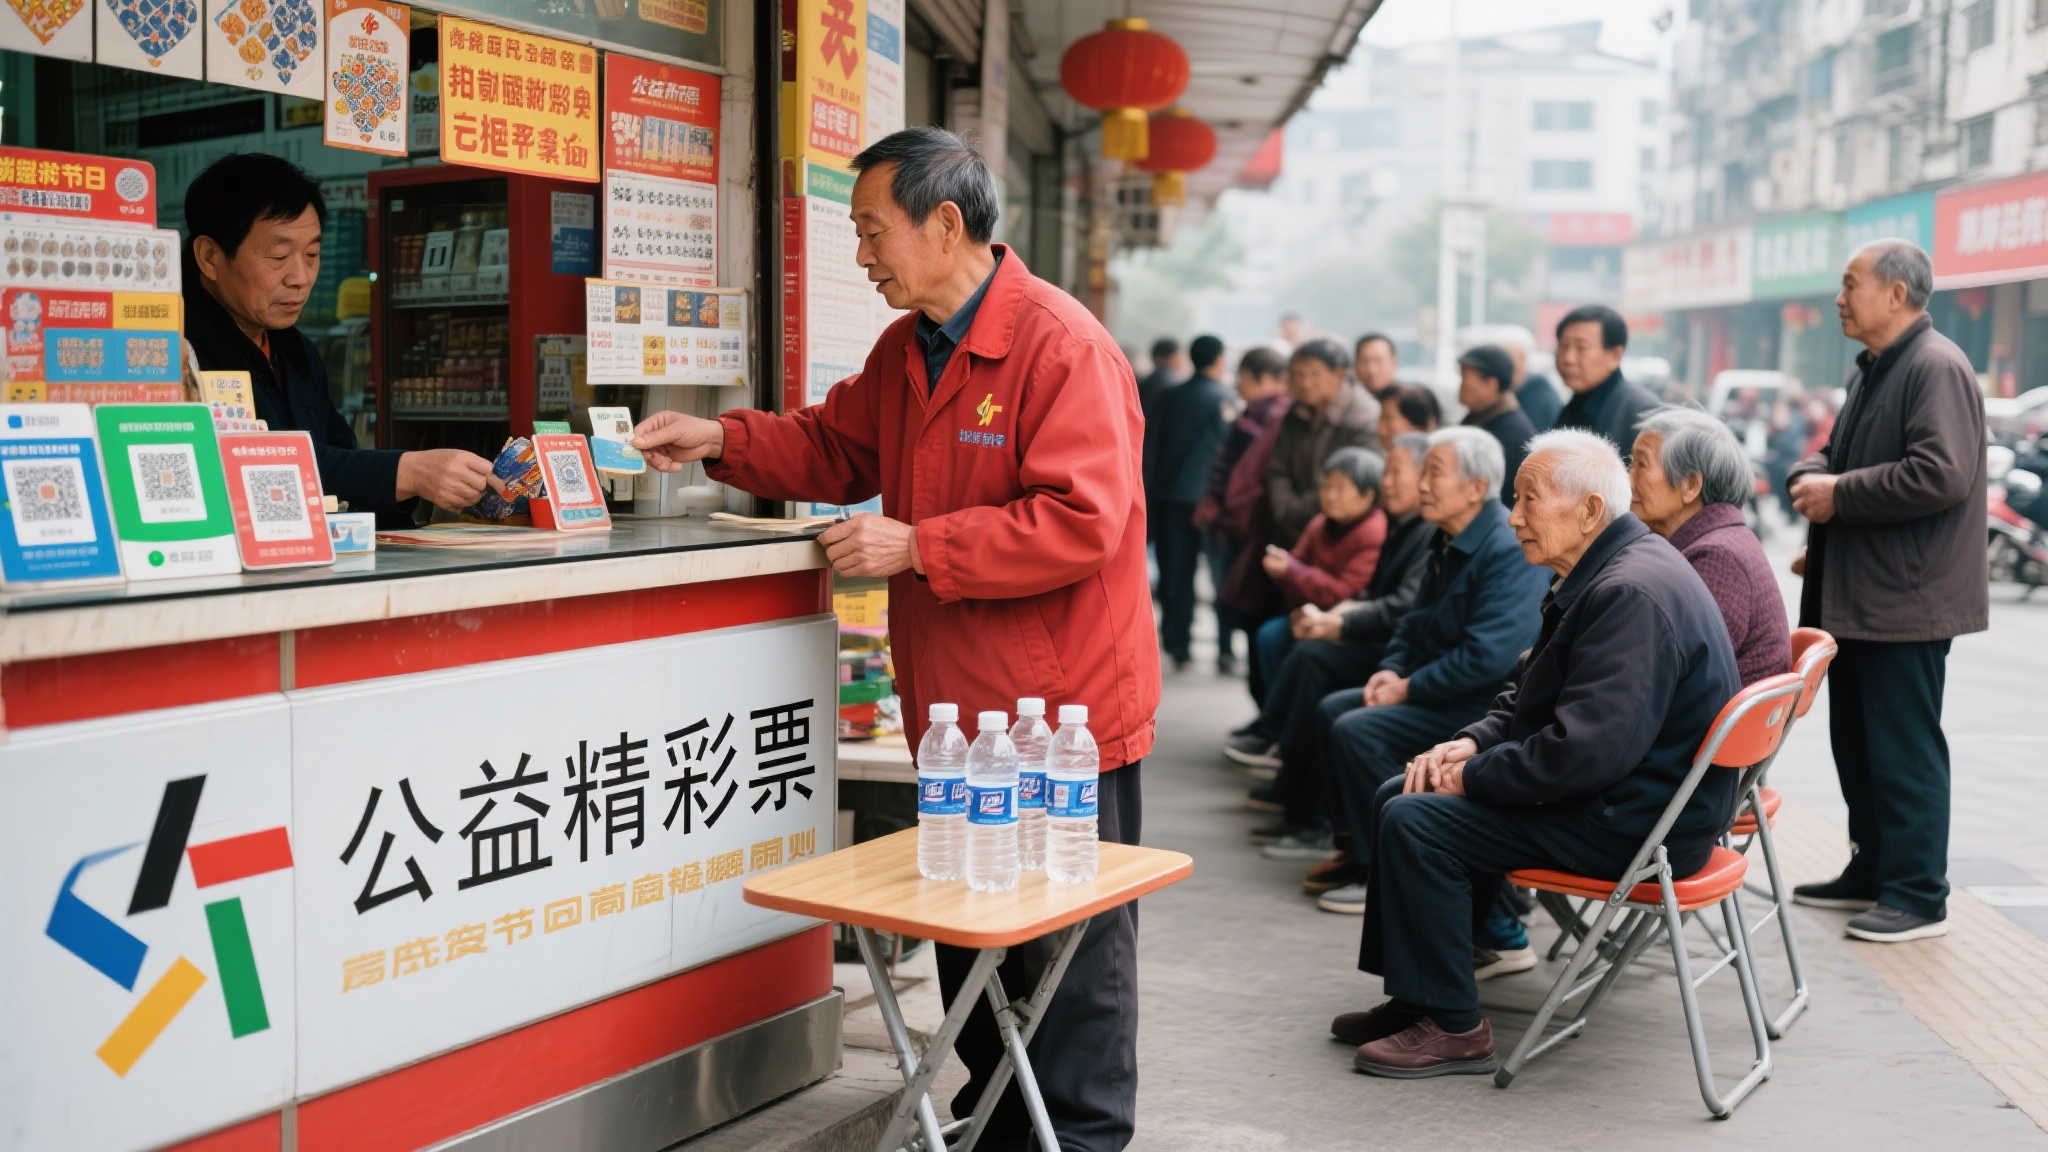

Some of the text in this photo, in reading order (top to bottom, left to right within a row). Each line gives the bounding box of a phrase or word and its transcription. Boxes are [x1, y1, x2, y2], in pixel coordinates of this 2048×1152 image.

[339, 698, 815, 915] 公益精彩票
